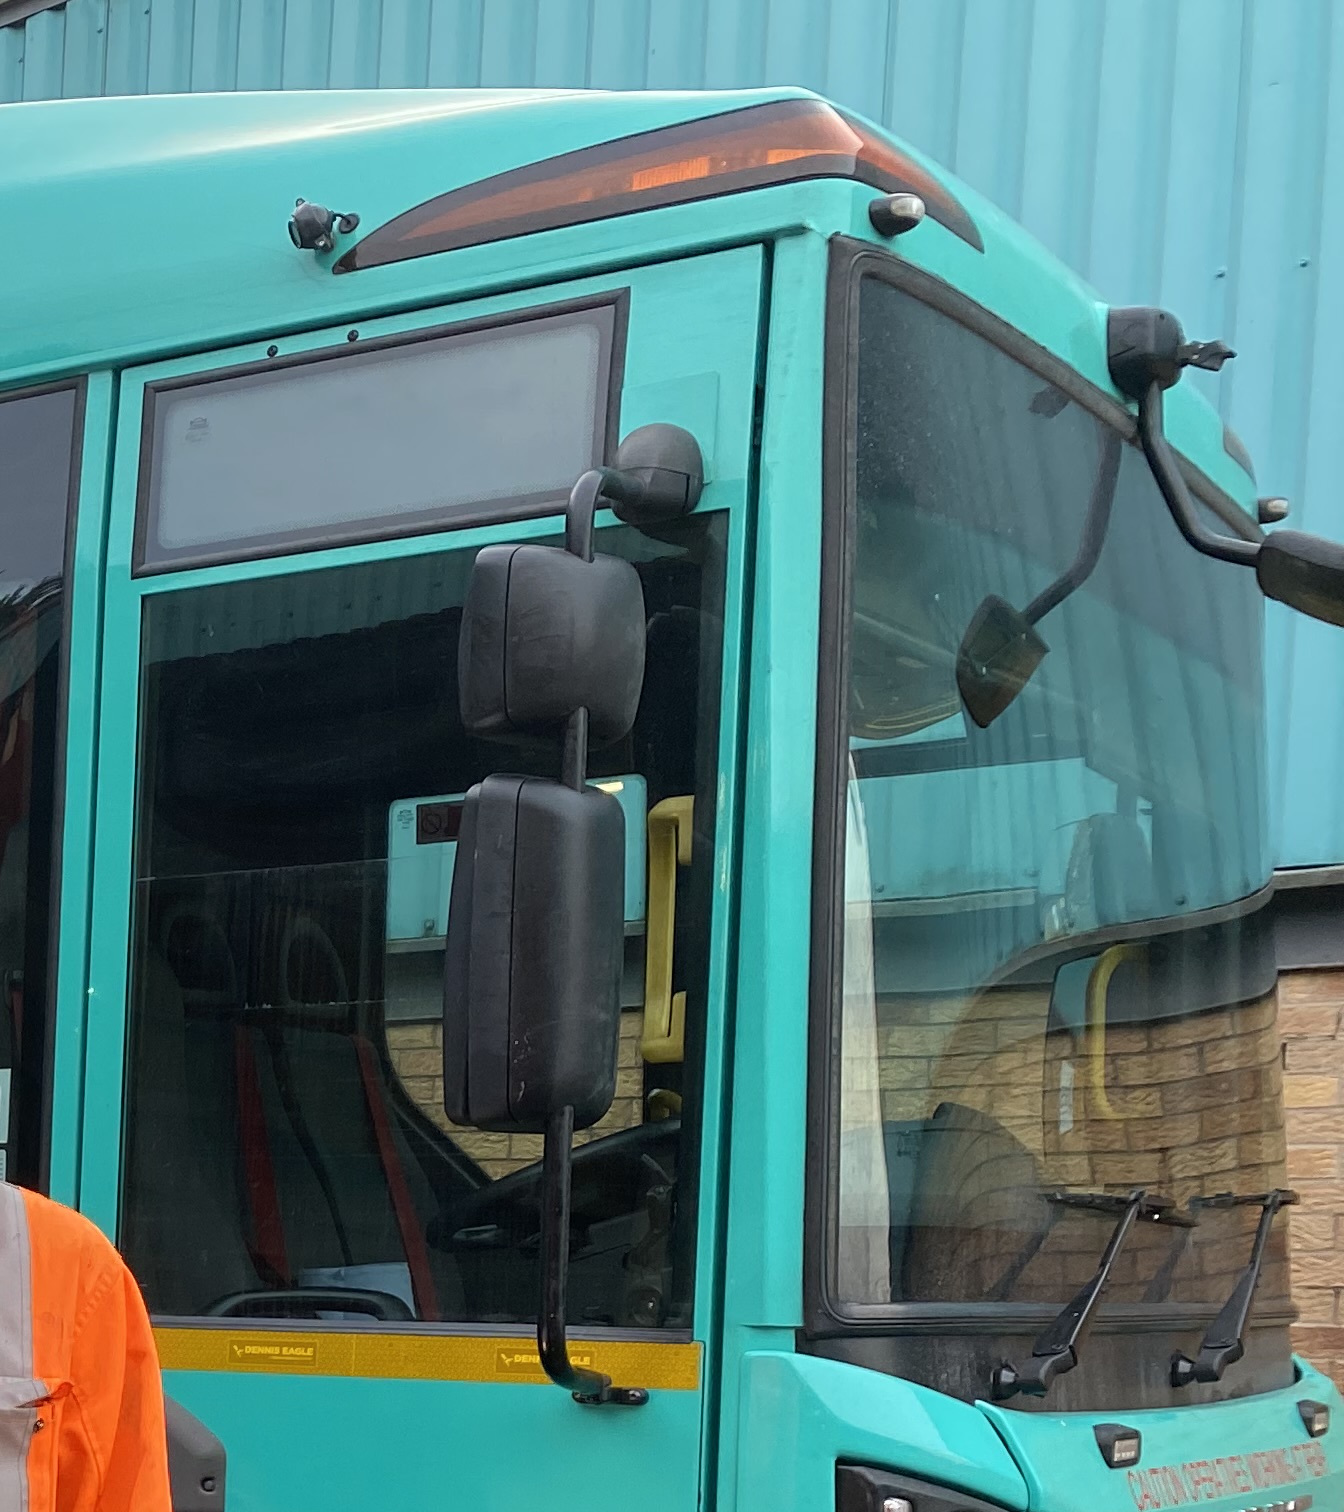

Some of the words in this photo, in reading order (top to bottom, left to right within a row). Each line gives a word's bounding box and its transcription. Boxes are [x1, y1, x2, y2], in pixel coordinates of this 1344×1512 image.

[244, 1345, 280, 1354] DENNIS
[282, 1346, 314, 1356] EAGLE
[569, 1356, 591, 1365] GLE
